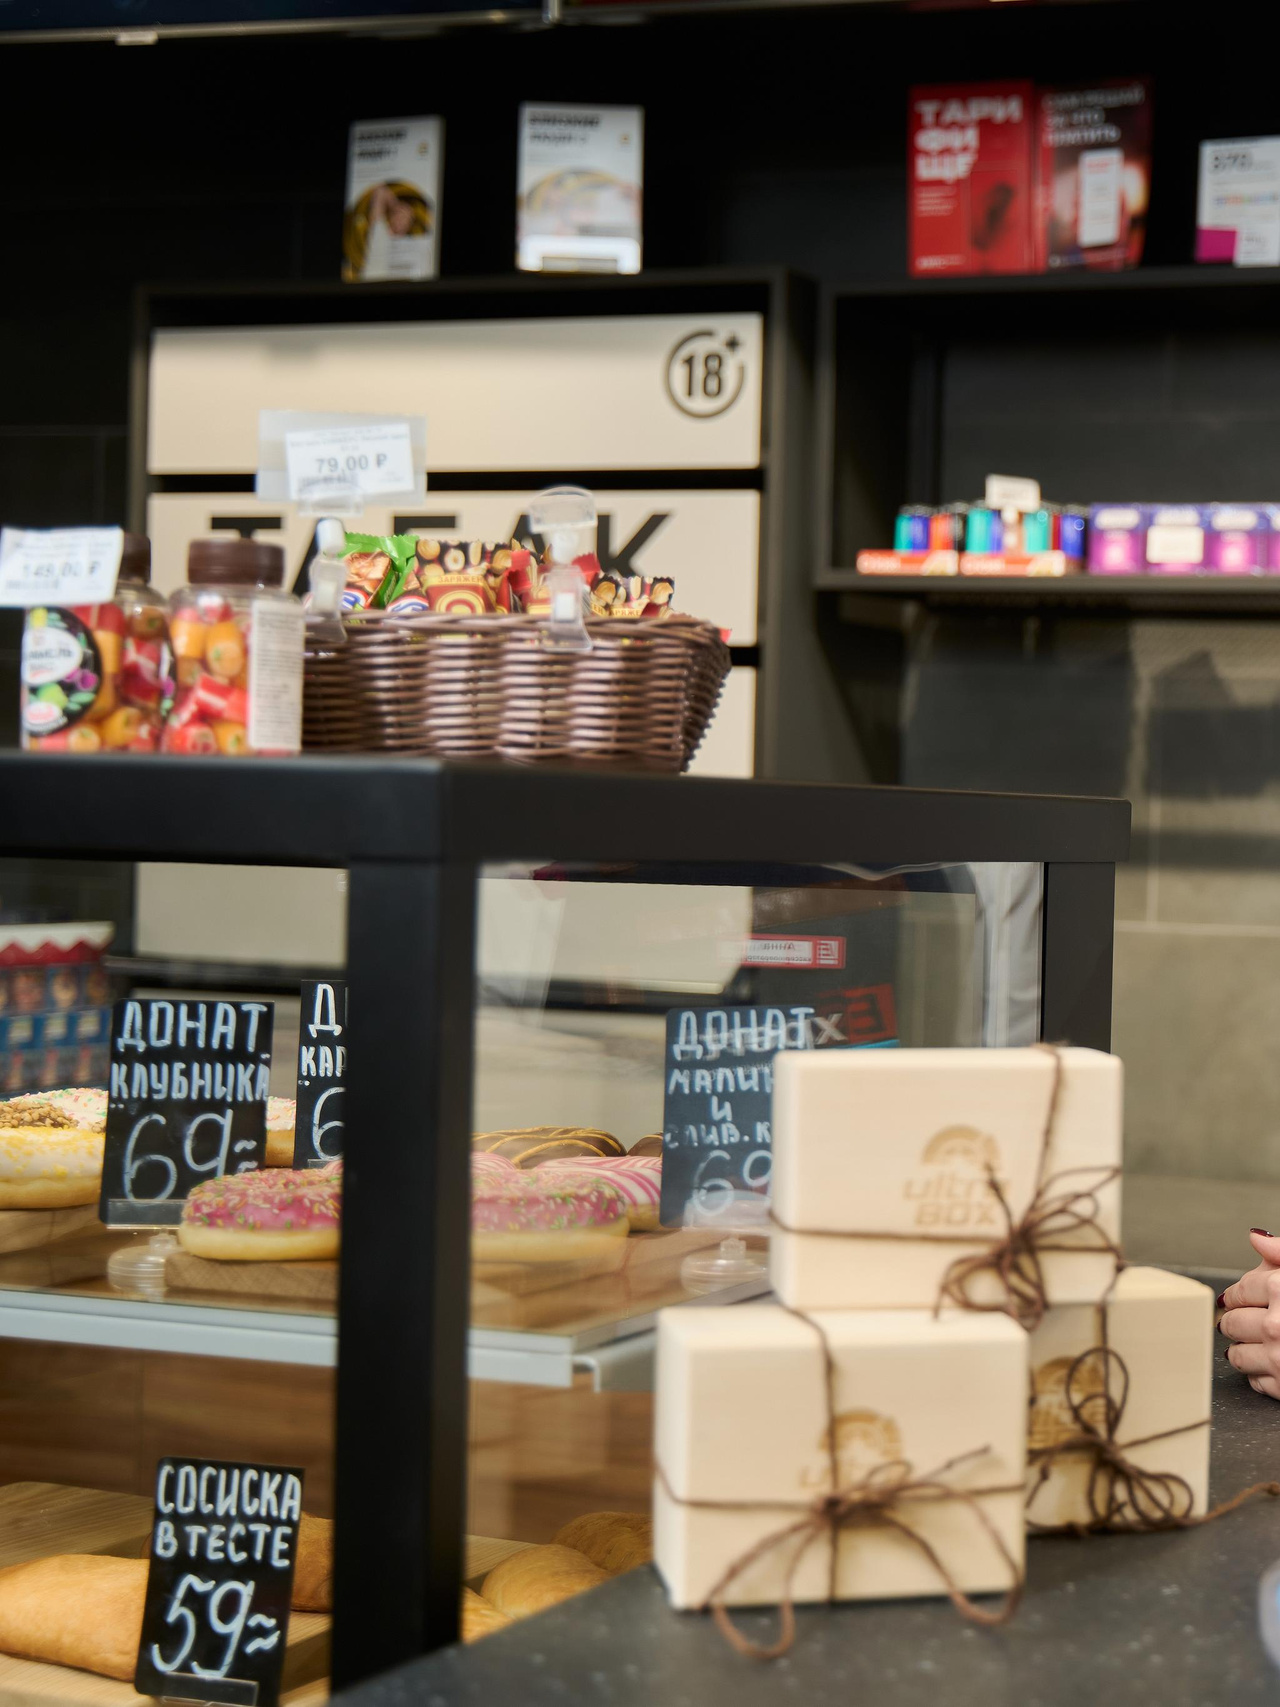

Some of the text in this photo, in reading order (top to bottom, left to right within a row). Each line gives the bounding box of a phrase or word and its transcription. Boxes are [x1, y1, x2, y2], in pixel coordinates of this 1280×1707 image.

[915, 97, 1023, 124] ТАРИ
[116, 1001, 269, 1052] ДОНАТ
[673, 1007, 815, 1061] ДОНАТ
[111, 1061, 270, 1102] КЛУБНИКА
[668, 1067, 775, 1095] МАЛИН
[157, 1464, 302, 1521] СОСИСКА
[155, 1521, 293, 1567] В ТЕСТЕ
